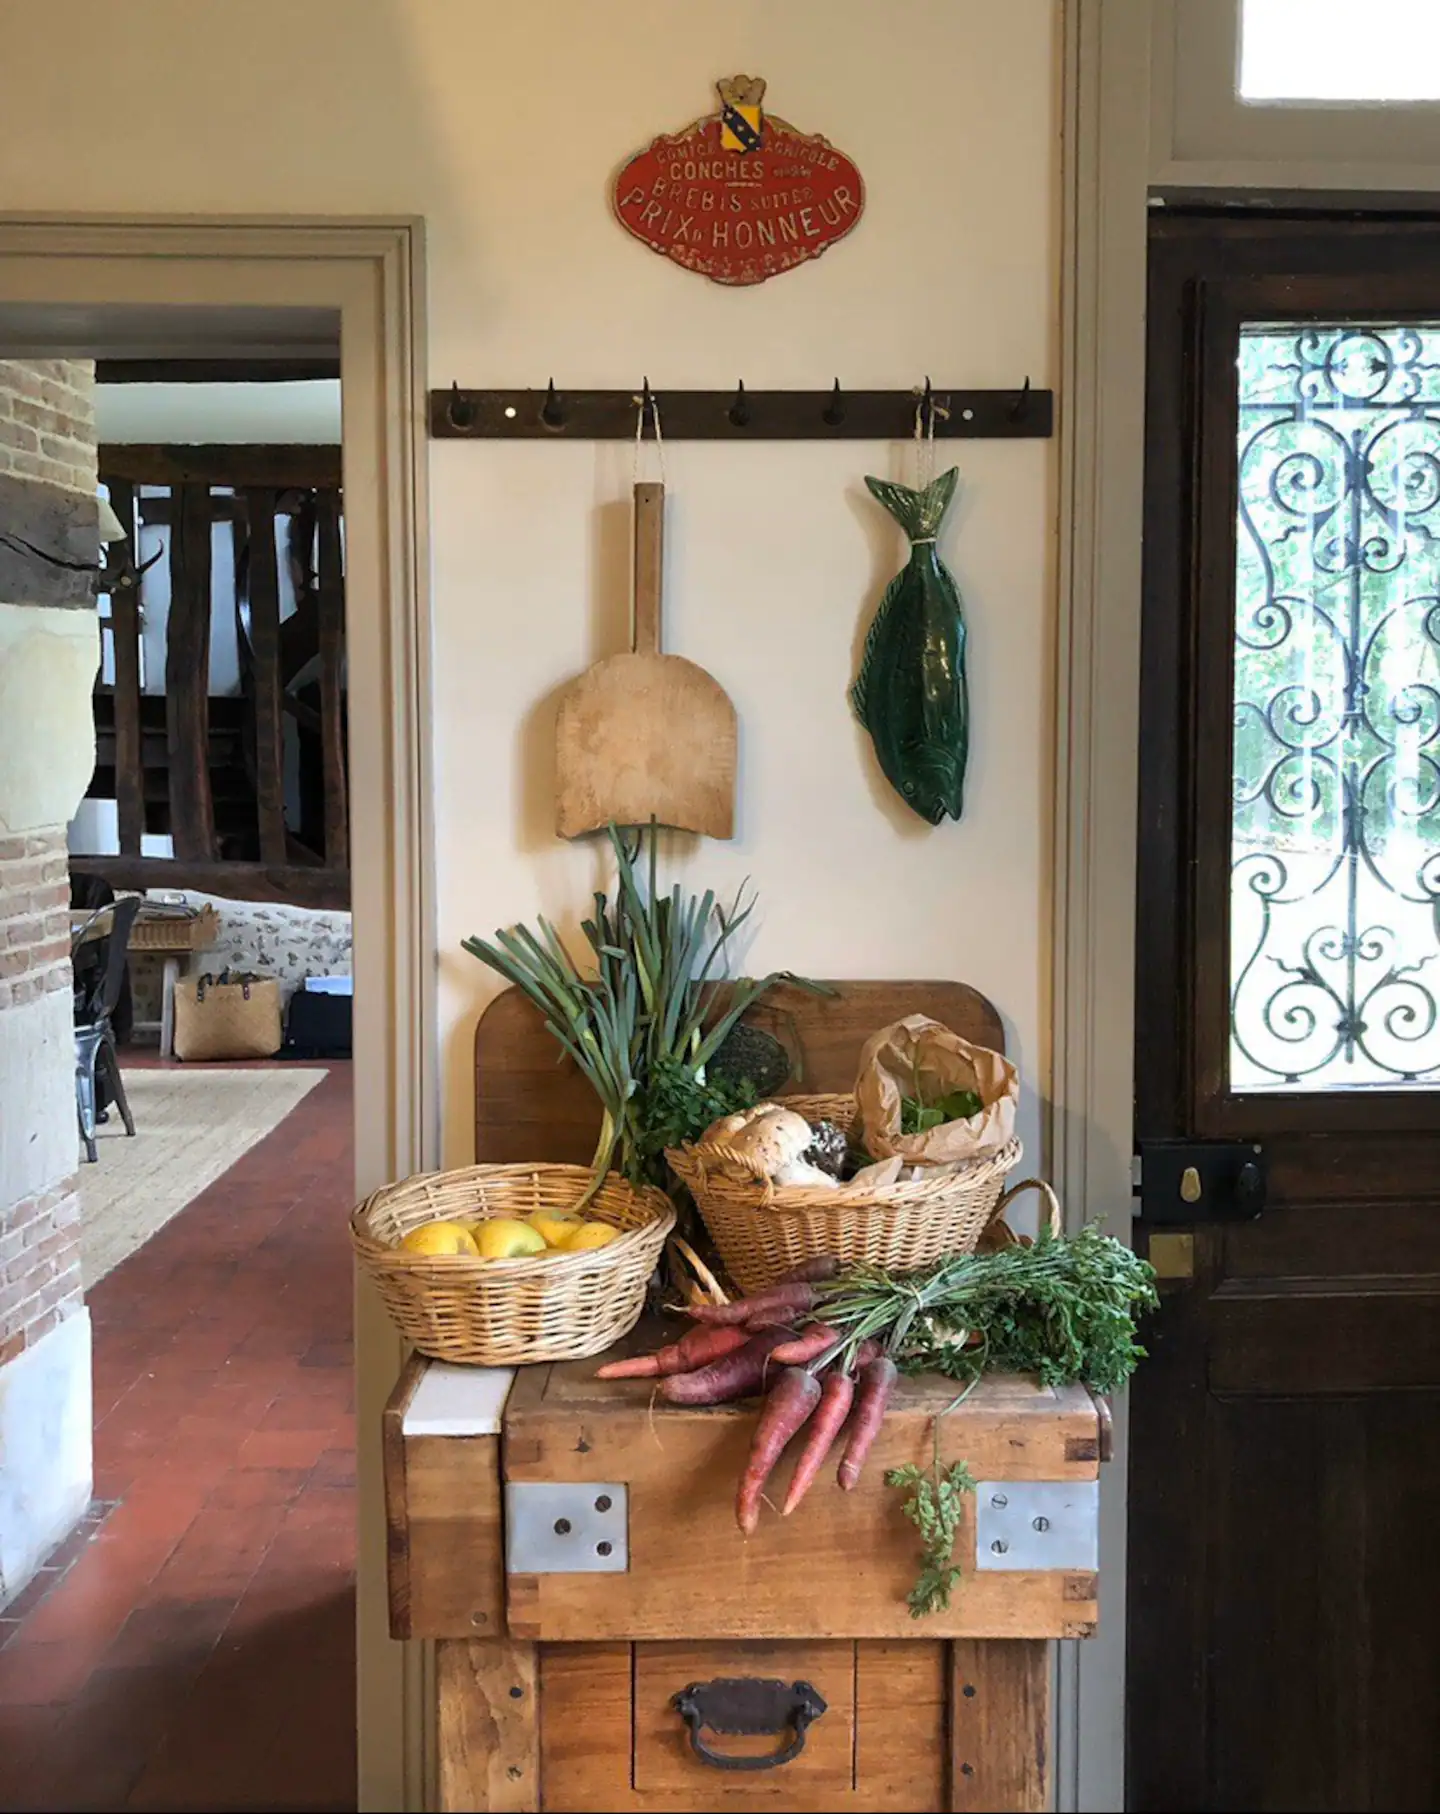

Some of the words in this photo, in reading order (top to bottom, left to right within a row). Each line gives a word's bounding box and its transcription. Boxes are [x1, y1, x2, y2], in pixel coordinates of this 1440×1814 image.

[670, 161, 764, 181] CONCHES
[652, 176, 742, 212] BREBIS
[620, 187, 694, 241] PRIX
